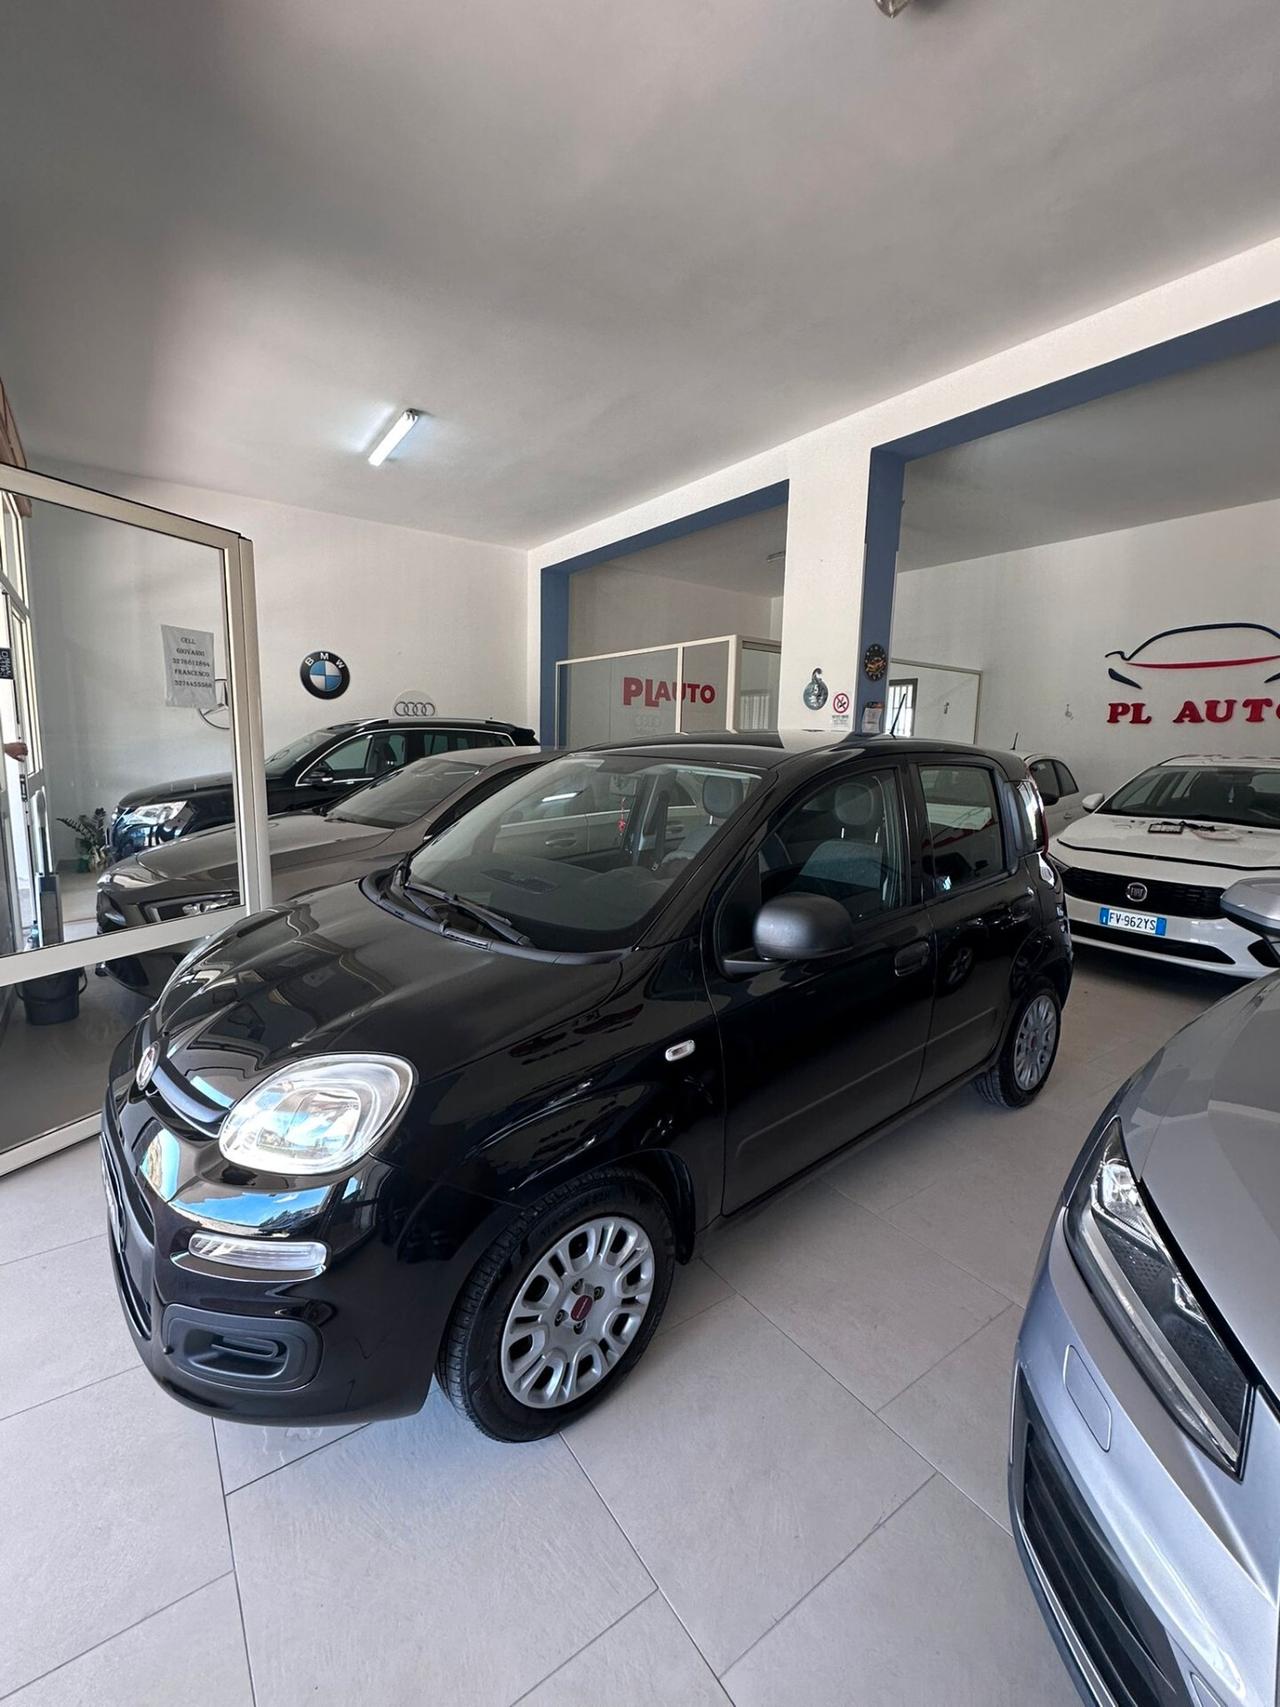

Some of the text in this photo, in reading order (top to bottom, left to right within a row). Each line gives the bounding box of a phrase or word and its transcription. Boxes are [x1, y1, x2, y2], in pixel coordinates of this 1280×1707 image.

[304, 651, 345, 669] BMW
[174, 668, 210, 678] FRANCESCO
[1106, 698, 1280, 724] PL AUT
